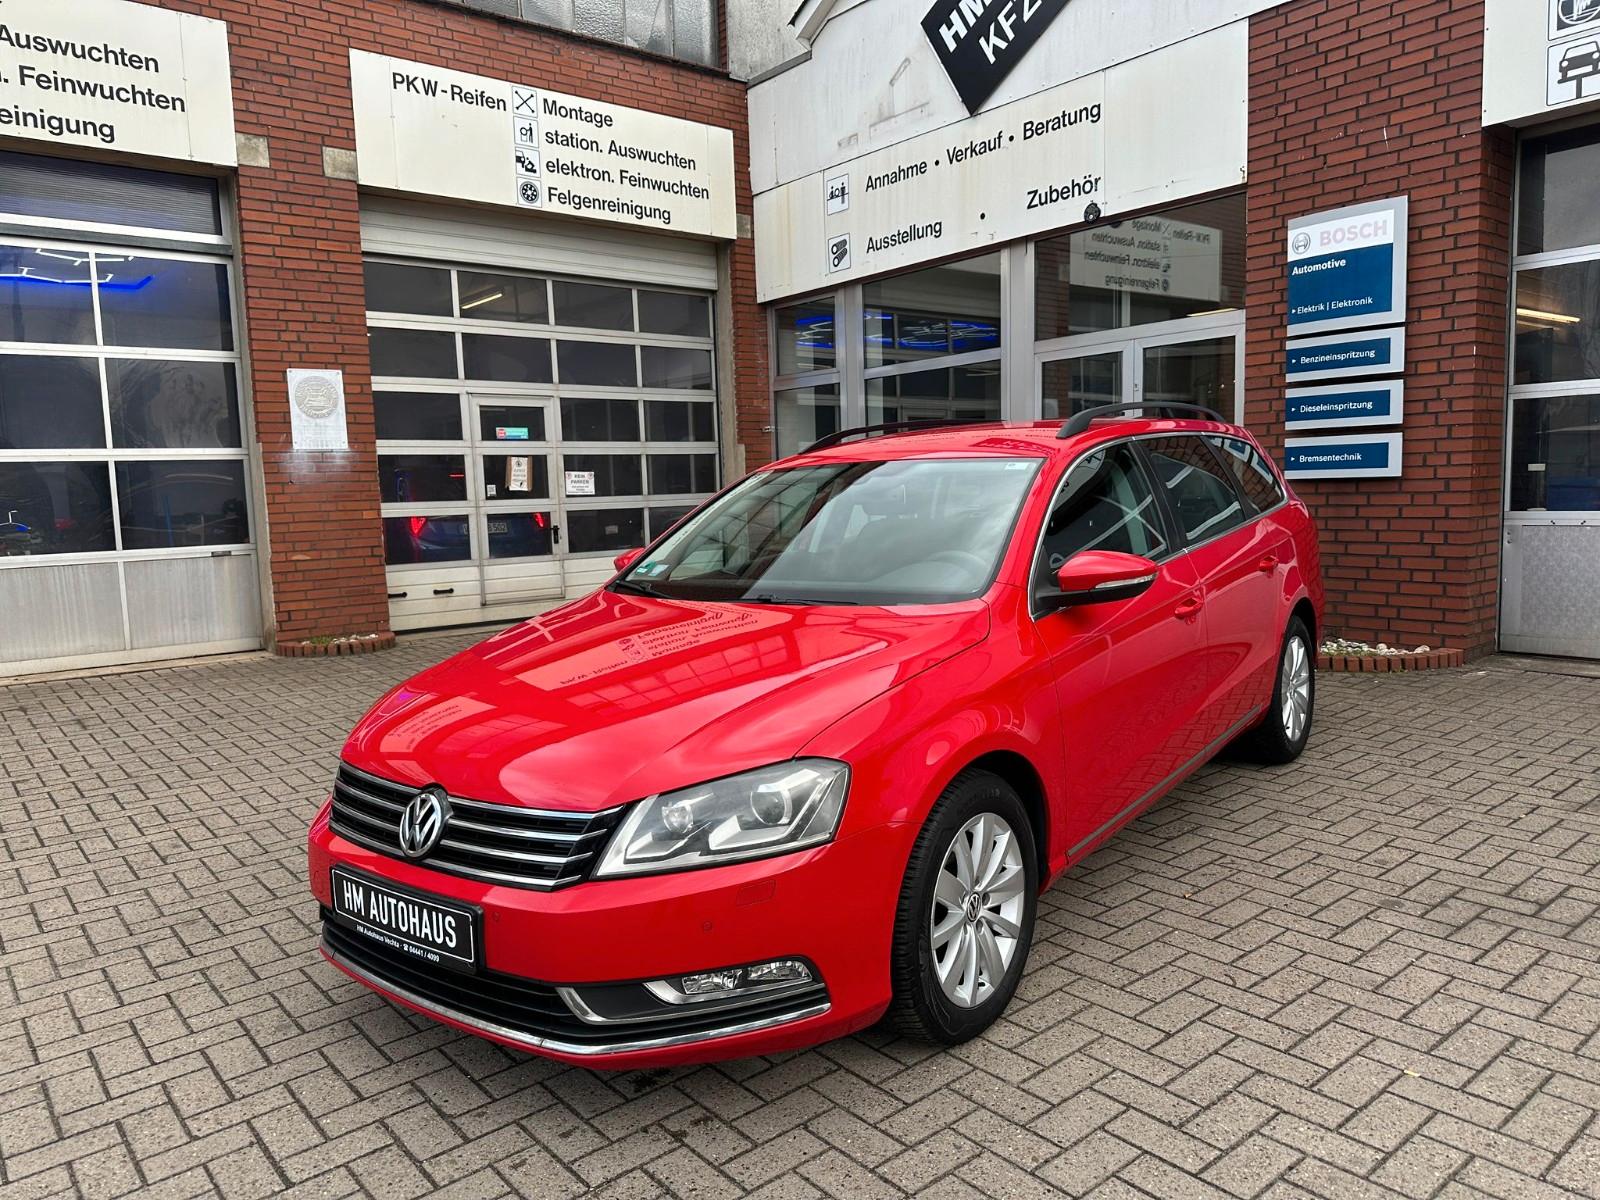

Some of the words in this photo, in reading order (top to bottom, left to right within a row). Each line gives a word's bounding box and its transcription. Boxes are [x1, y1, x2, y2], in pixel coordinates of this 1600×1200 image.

[0, 24, 160, 73] Auswuchten
[18, 64, 187, 113] Feinwuchten
[392, 71, 507, 112] PKW-Reifen
[0, 104, 116, 144] einigung
[543, 98, 614, 128] Montage
[545, 128, 604, 154] station.
[608, 139, 697, 171] Auswuchten
[865, 159, 928, 193] Annahme
[946, 131, 1004, 166] Verkauf
[1023, 103, 1102, 141] Beratung
[545, 158, 615, 184] elektron.
[619, 169, 710, 200] Feinwuchten
[547, 186, 672, 225] Felgenreinigung
[866, 220, 943, 254] Ausstellung
[1026, 173, 1102, 210] Zubehör
[1319, 219, 1388, 248] BOSCH
[1291, 258, 1347, 276] Automotive
[1297, 302, 1326, 315] Elektrik
[1331, 296, 1374, 310] Elektronik
[1300, 349, 1376, 365] Benzineinspritzung
[1300, 401, 1373, 414] Dieseleinspritzung
[1299, 452, 1363, 463] Bremsentechnik
[342, 879, 365, 916] HM
[369, 890, 457, 948] AUTOHAUS
[356, 924, 364, 933] HM
[363, 928, 384, 942] Autohaus
[384, 936, 400, 949] Vechta
